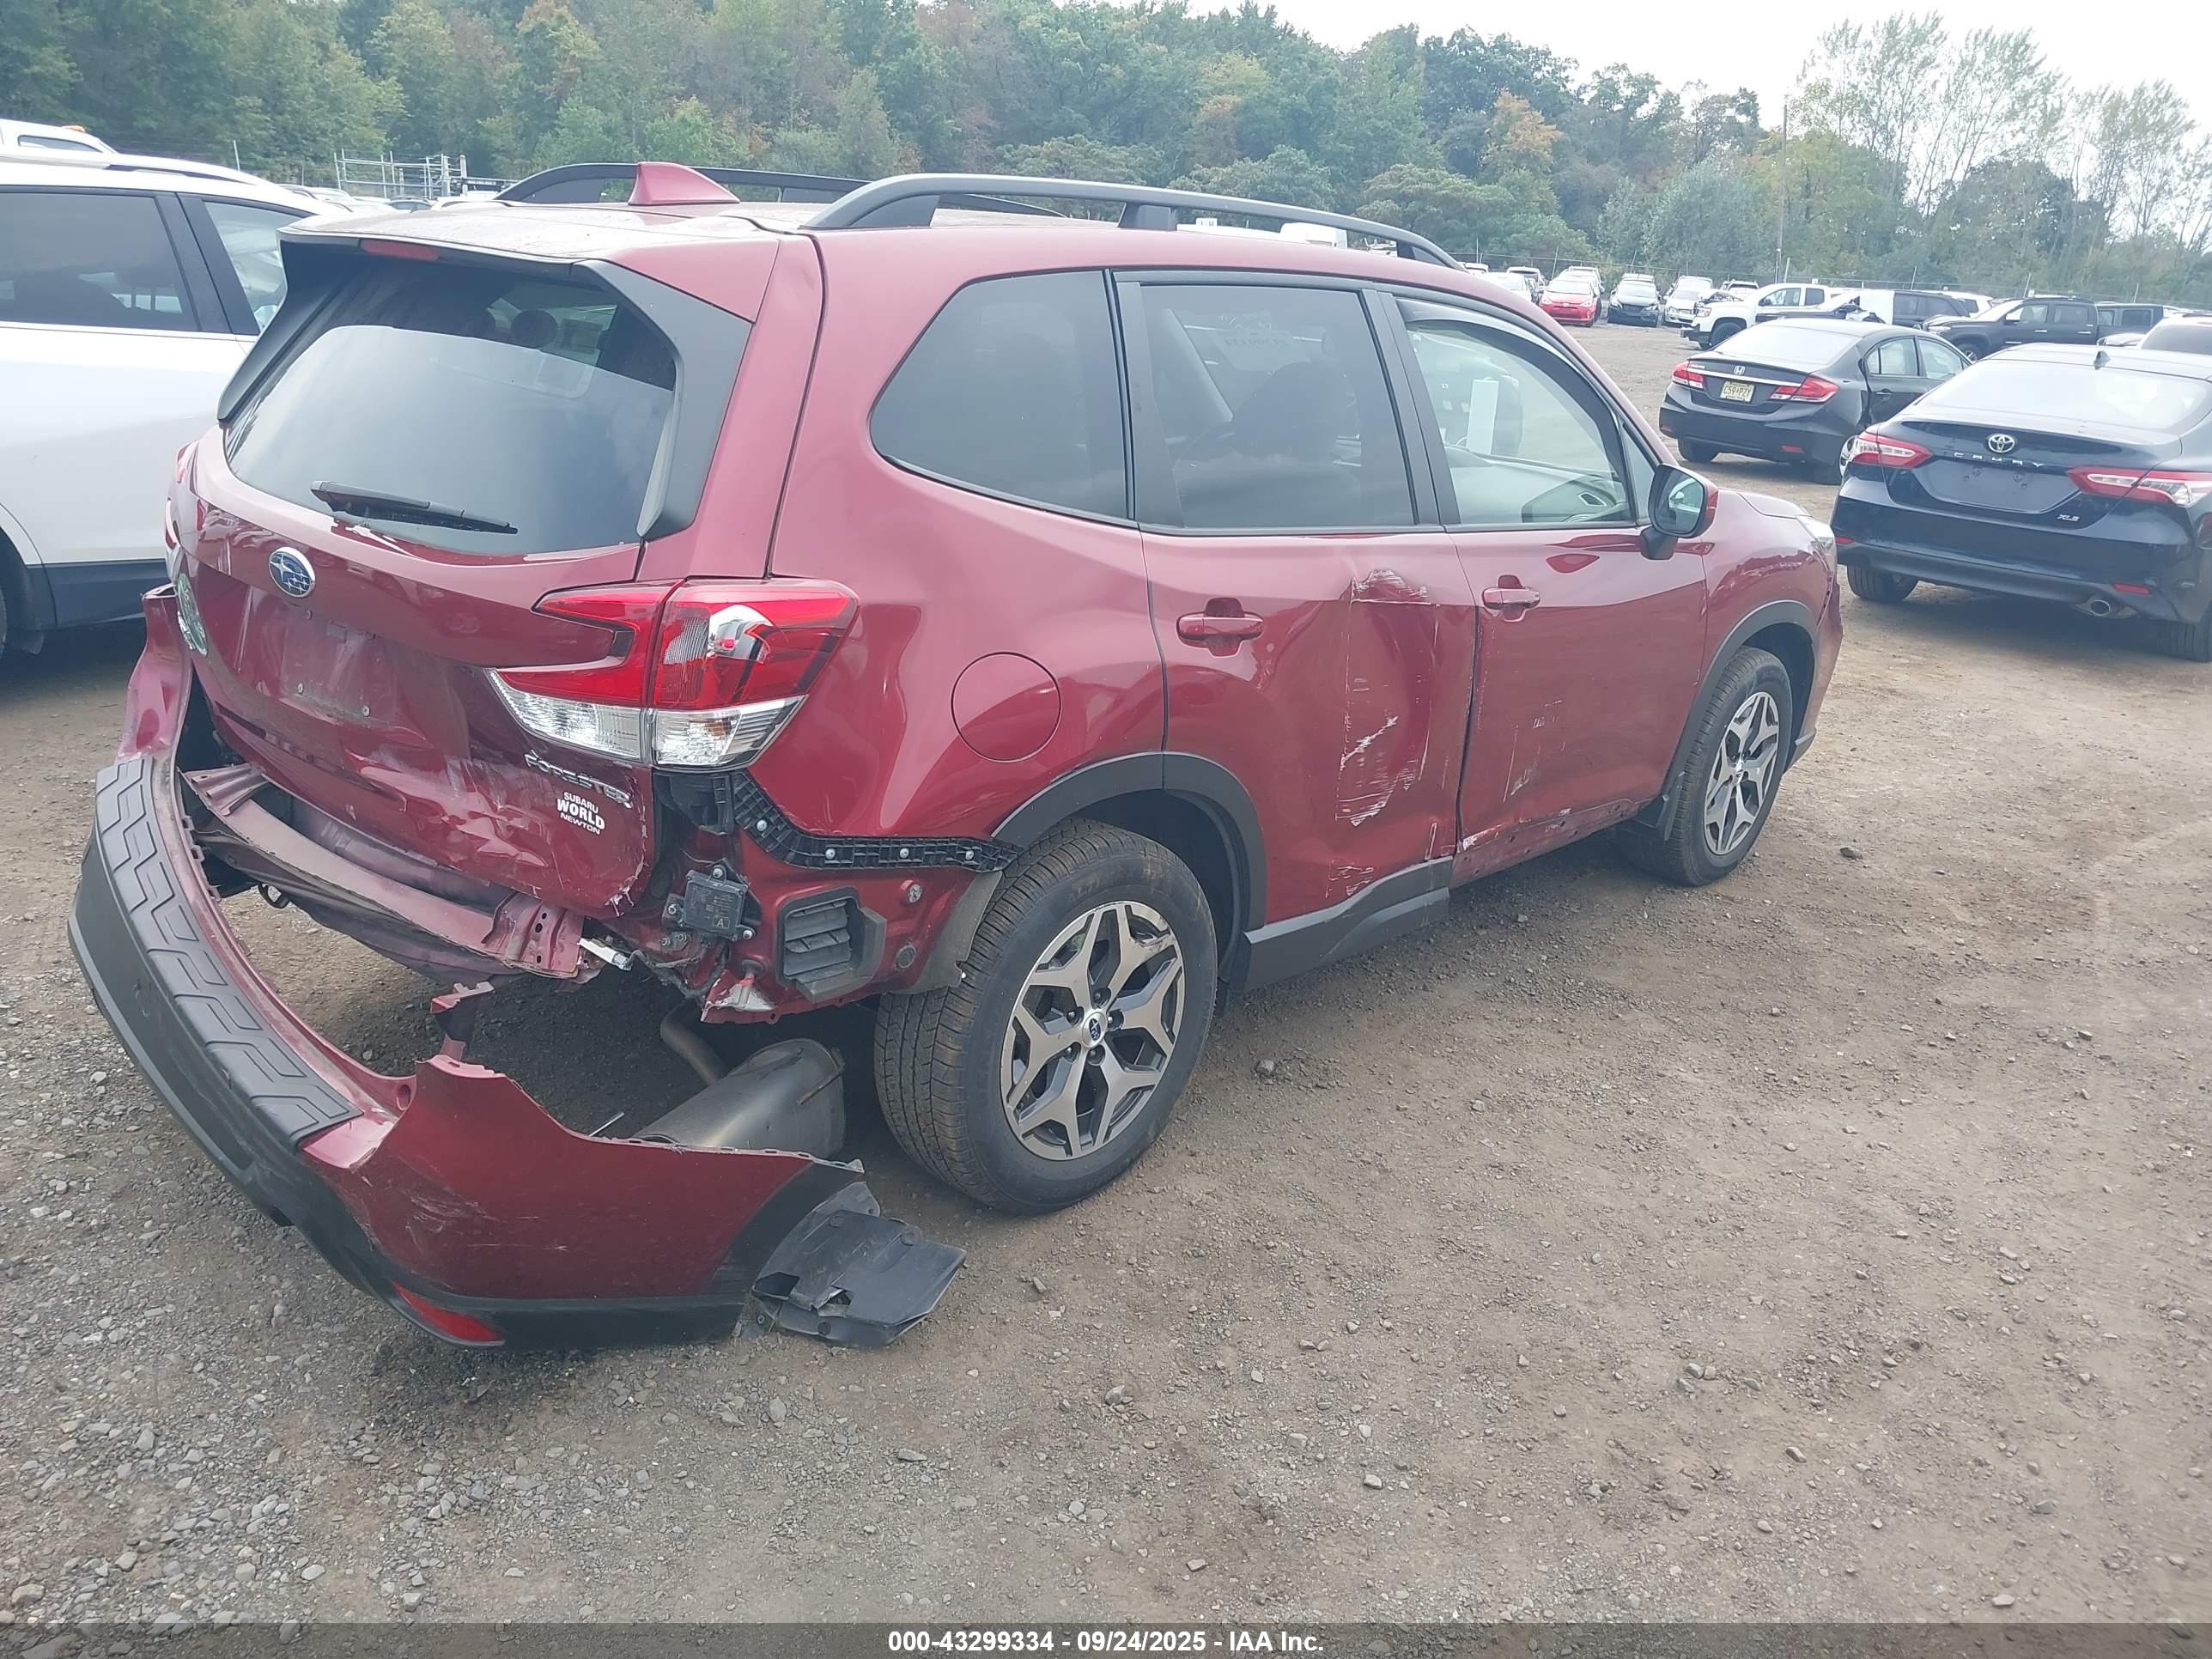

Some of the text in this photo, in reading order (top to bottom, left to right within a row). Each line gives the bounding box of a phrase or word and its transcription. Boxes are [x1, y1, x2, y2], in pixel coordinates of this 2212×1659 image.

[1954, 452, 2045, 468] CAMRY
[525, 752, 634, 808] FORESTER
[556, 799, 605, 830] WORLD
[563, 792, 599, 813] SUBARU
[560, 812, 601, 836] NEWTON
